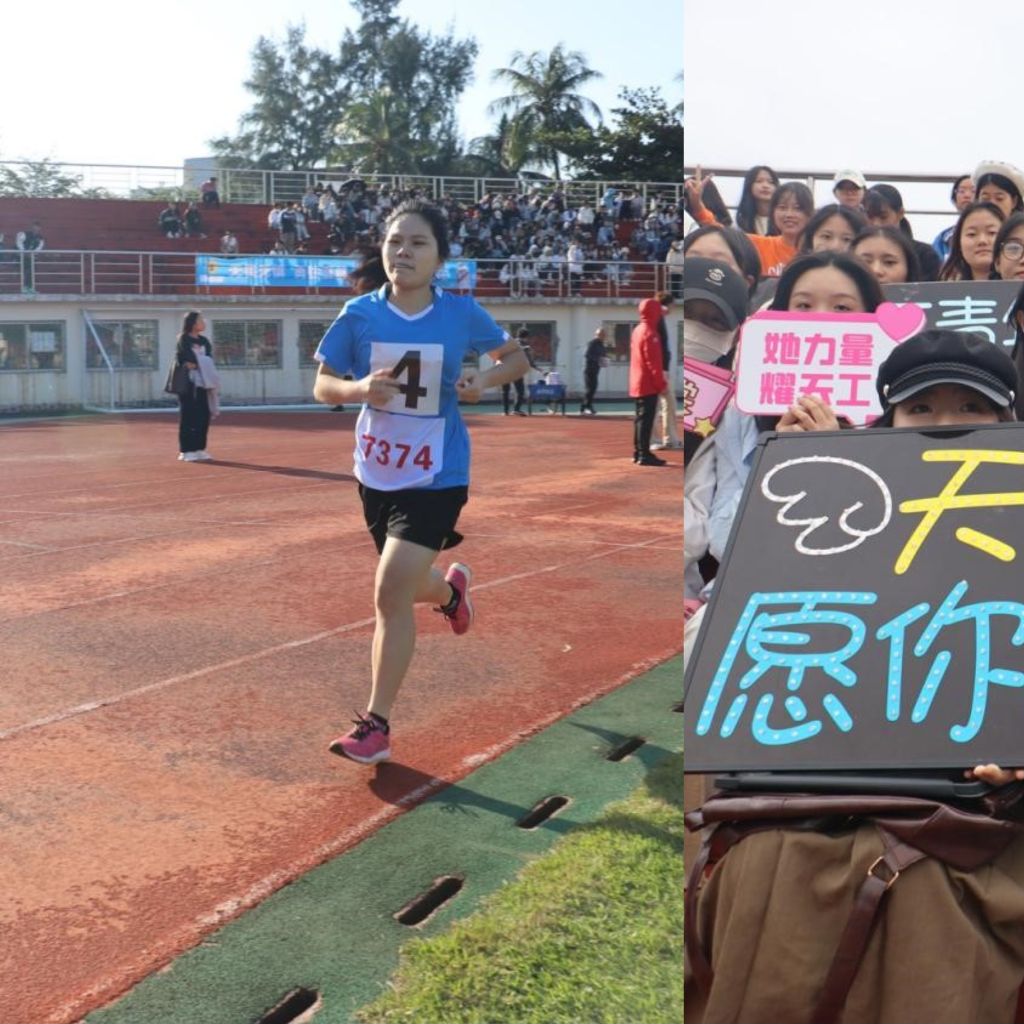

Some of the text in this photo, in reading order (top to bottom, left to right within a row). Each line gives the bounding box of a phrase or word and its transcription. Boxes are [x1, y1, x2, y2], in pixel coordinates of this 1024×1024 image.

[763, 333, 874, 367] 她力量
[391, 350, 428, 410] 4
[760, 372, 872, 407] 耀天工
[362, 434, 433, 471] 7374
